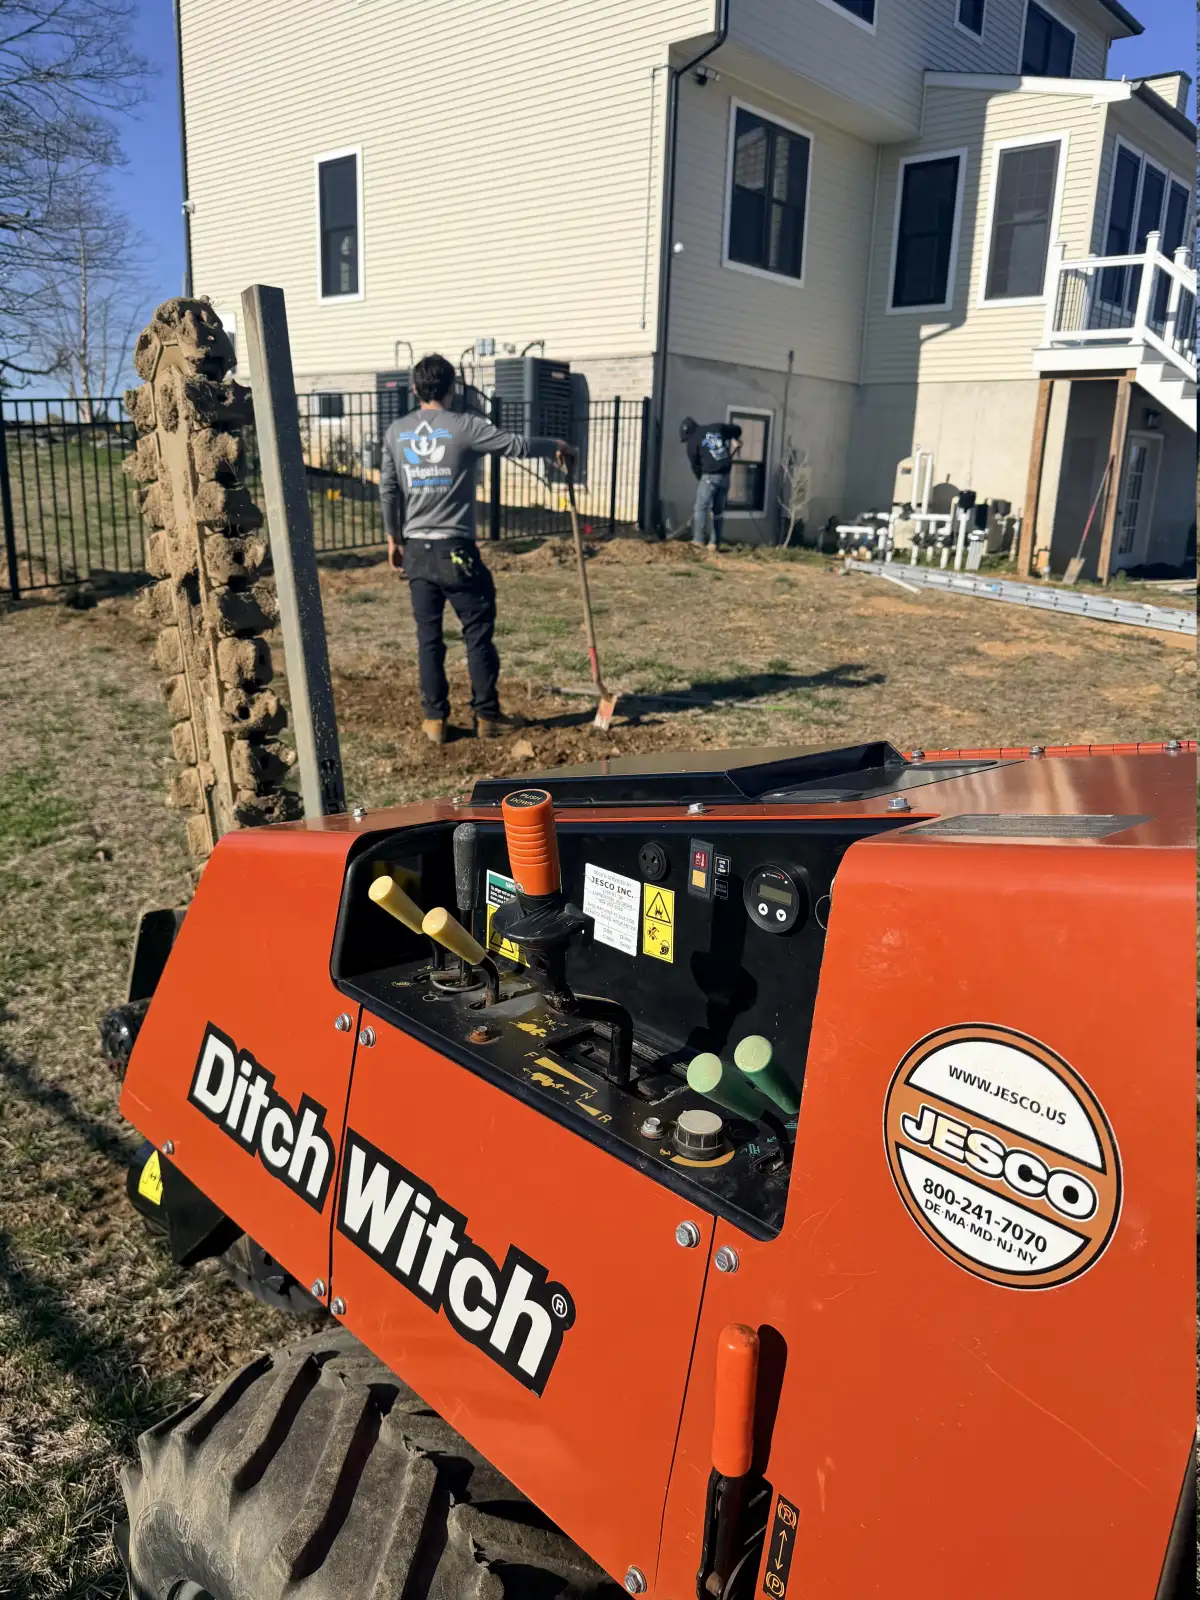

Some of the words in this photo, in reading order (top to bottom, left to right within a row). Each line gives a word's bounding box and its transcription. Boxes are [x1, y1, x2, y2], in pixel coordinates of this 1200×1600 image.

[510, 798, 535, 806] DOWN
[591, 875, 614, 891] JESCO
[616, 885, 633, 898] INC.
[193, 1033, 331, 1199] Ditch
[580, 1092, 594, 1100] N
[597, 1113, 613, 1123] R
[948, 1065, 1067, 1126] WWW.JESCO.US
[901, 1104, 1098, 1222] JESCO
[922, 1177, 1048, 1254] 800-241-7070
[343, 1143, 553, 1379] Witch
